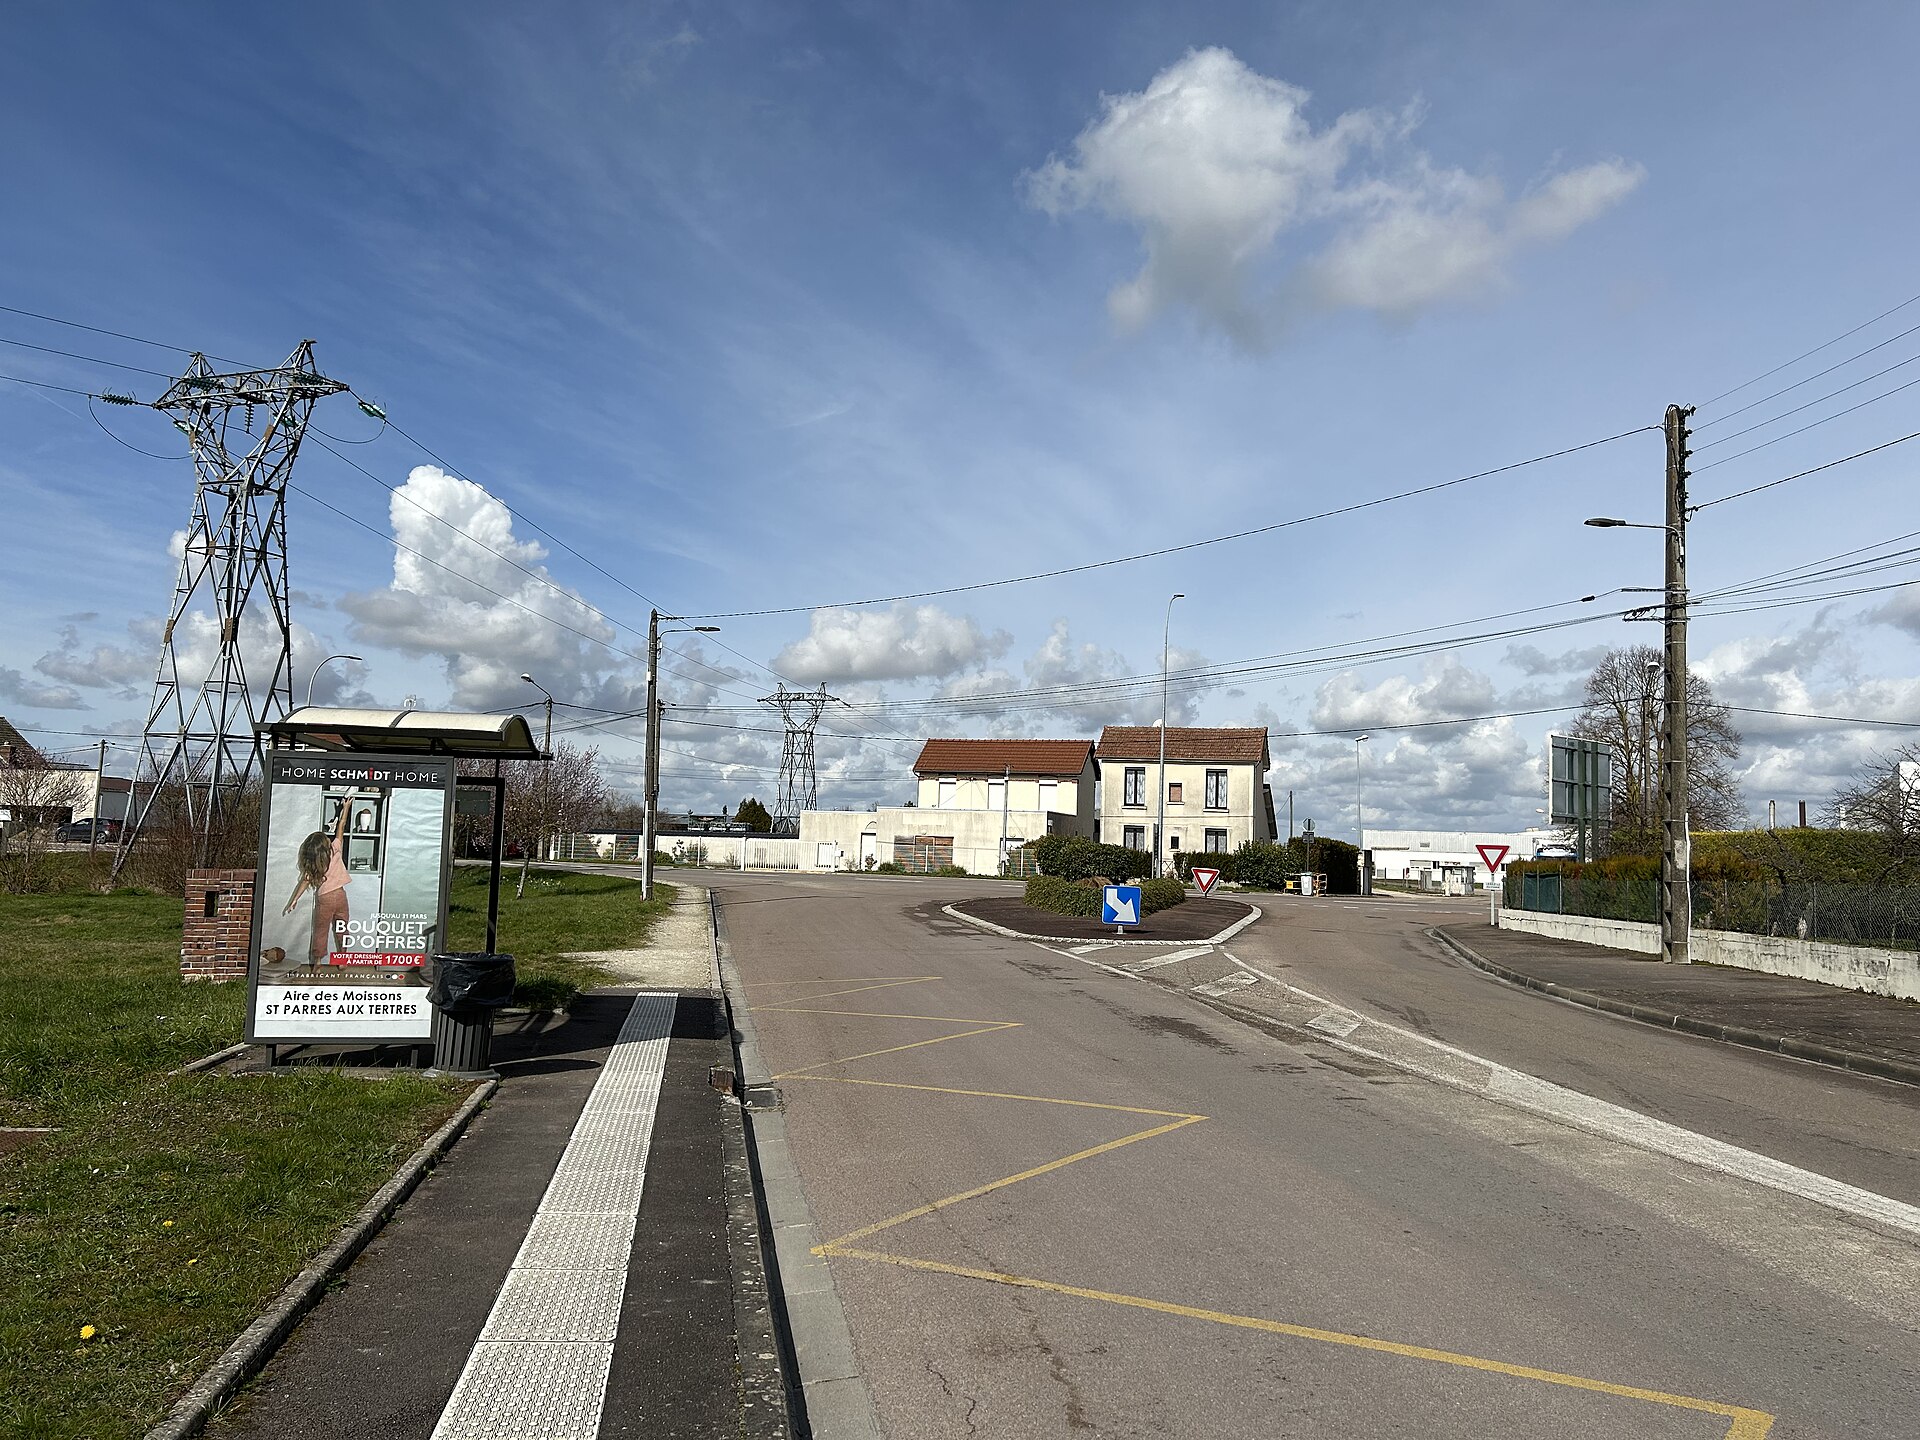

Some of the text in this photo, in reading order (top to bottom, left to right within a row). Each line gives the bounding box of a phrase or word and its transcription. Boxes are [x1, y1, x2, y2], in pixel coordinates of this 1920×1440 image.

[282, 767, 326, 779] HOME
[394, 770, 438, 783] HOME
[335, 919, 428, 936] BOUQUET
[342, 934, 426, 949] D'OFFRES
[283, 990, 402, 1001] Aire des Moissons
[266, 1004, 417, 1015] ST PARRES AUX TERTRES
